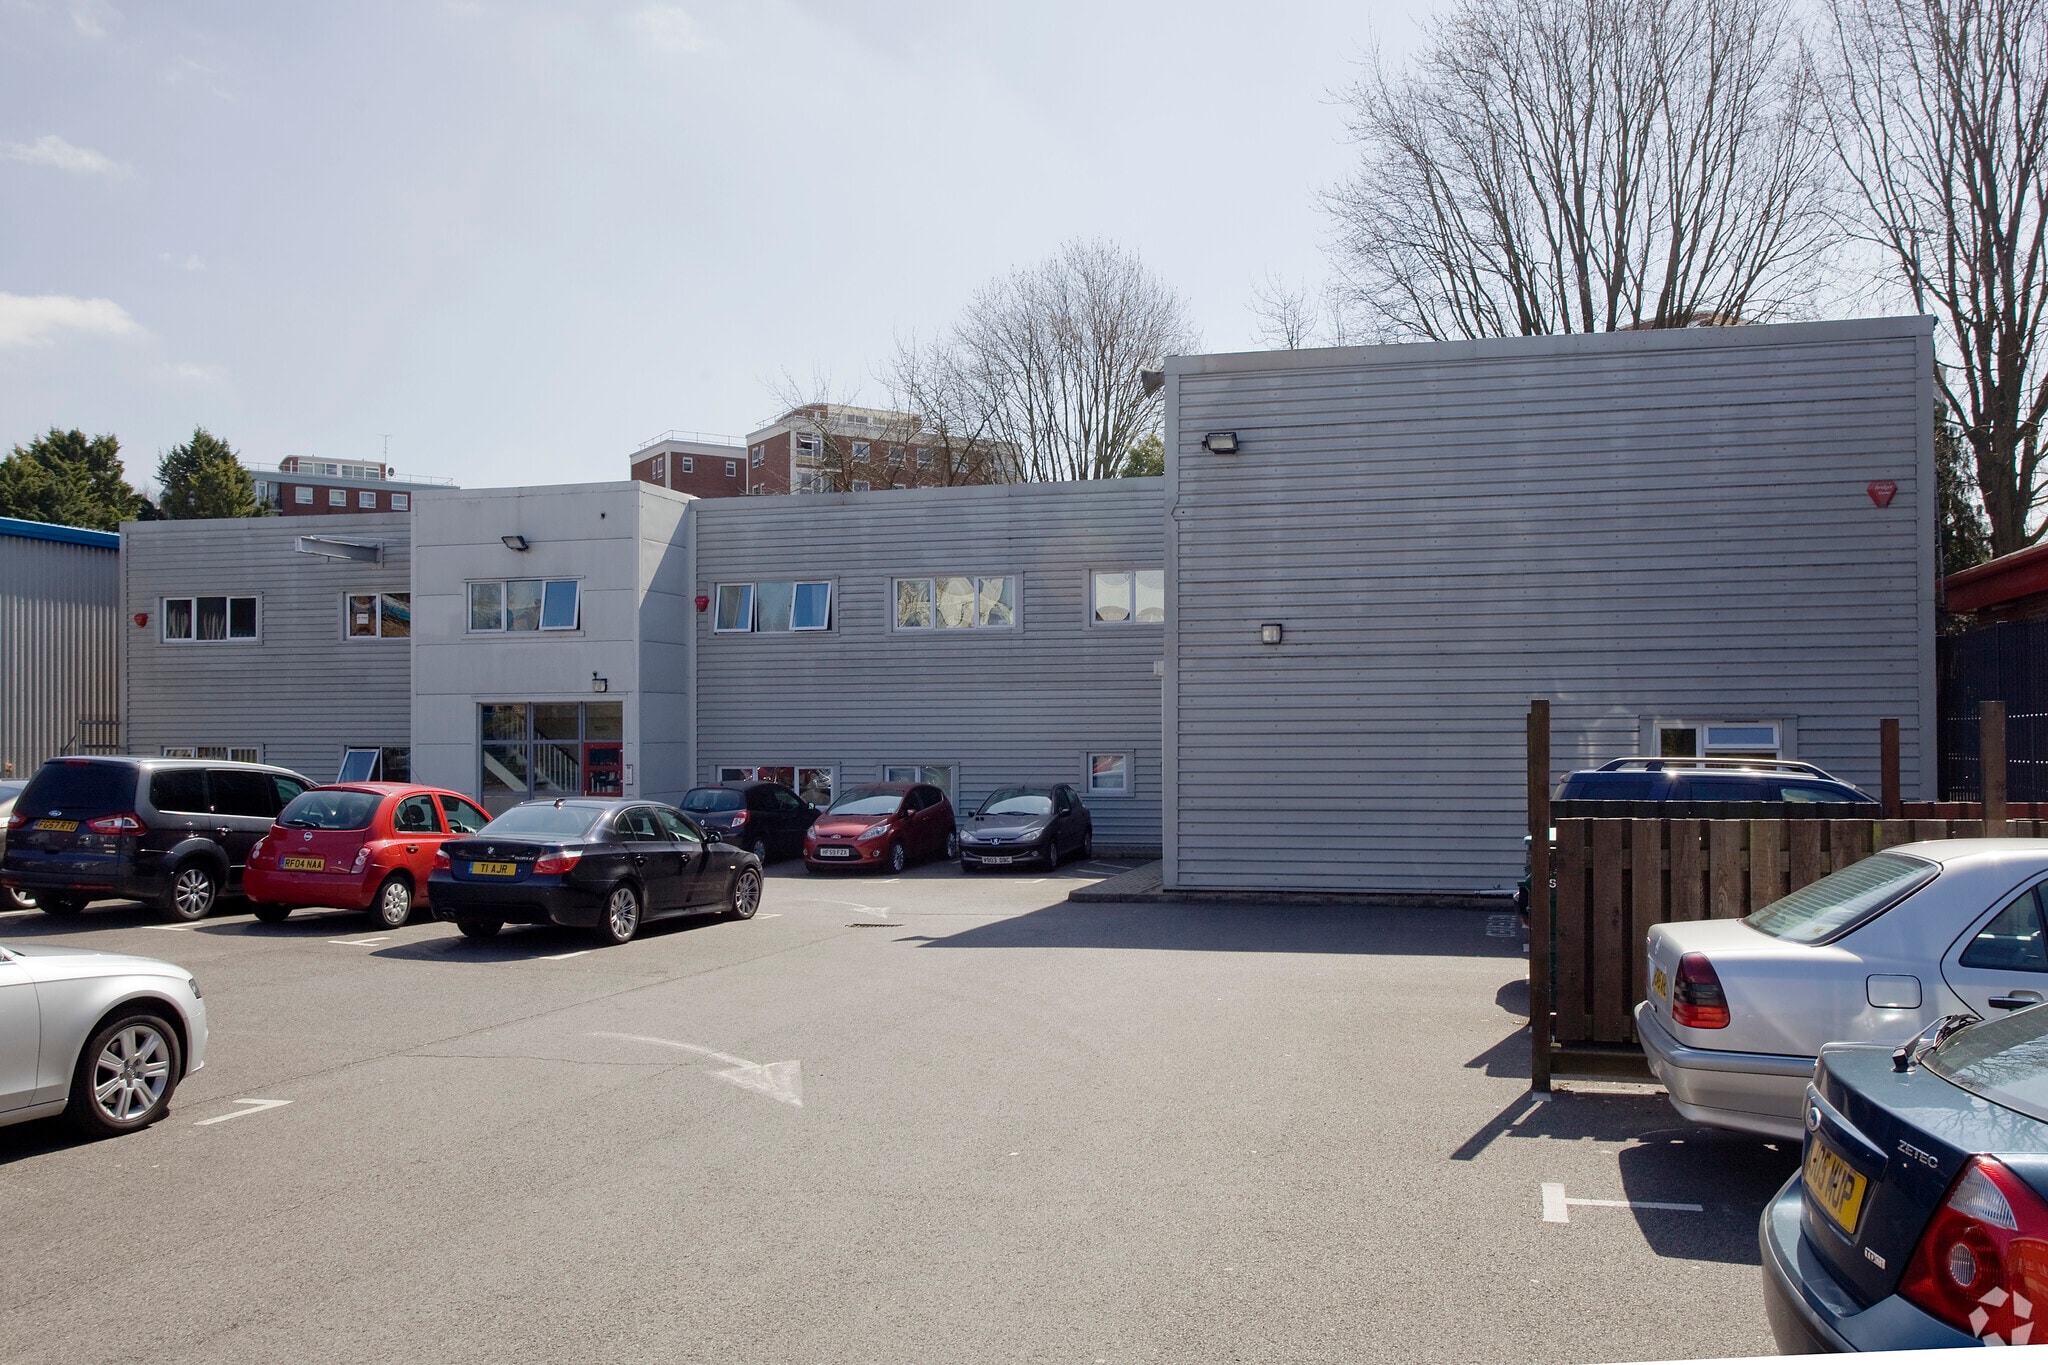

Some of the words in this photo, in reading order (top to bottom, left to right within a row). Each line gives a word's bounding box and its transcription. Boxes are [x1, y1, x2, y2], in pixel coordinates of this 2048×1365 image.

[61, 821, 78, 832] RTU
[284, 858, 305, 868] RF04
[306, 859, 322, 869] NAA
[491, 864, 508, 874] AJR
[1897, 1139, 1938, 1168] ZETEC
